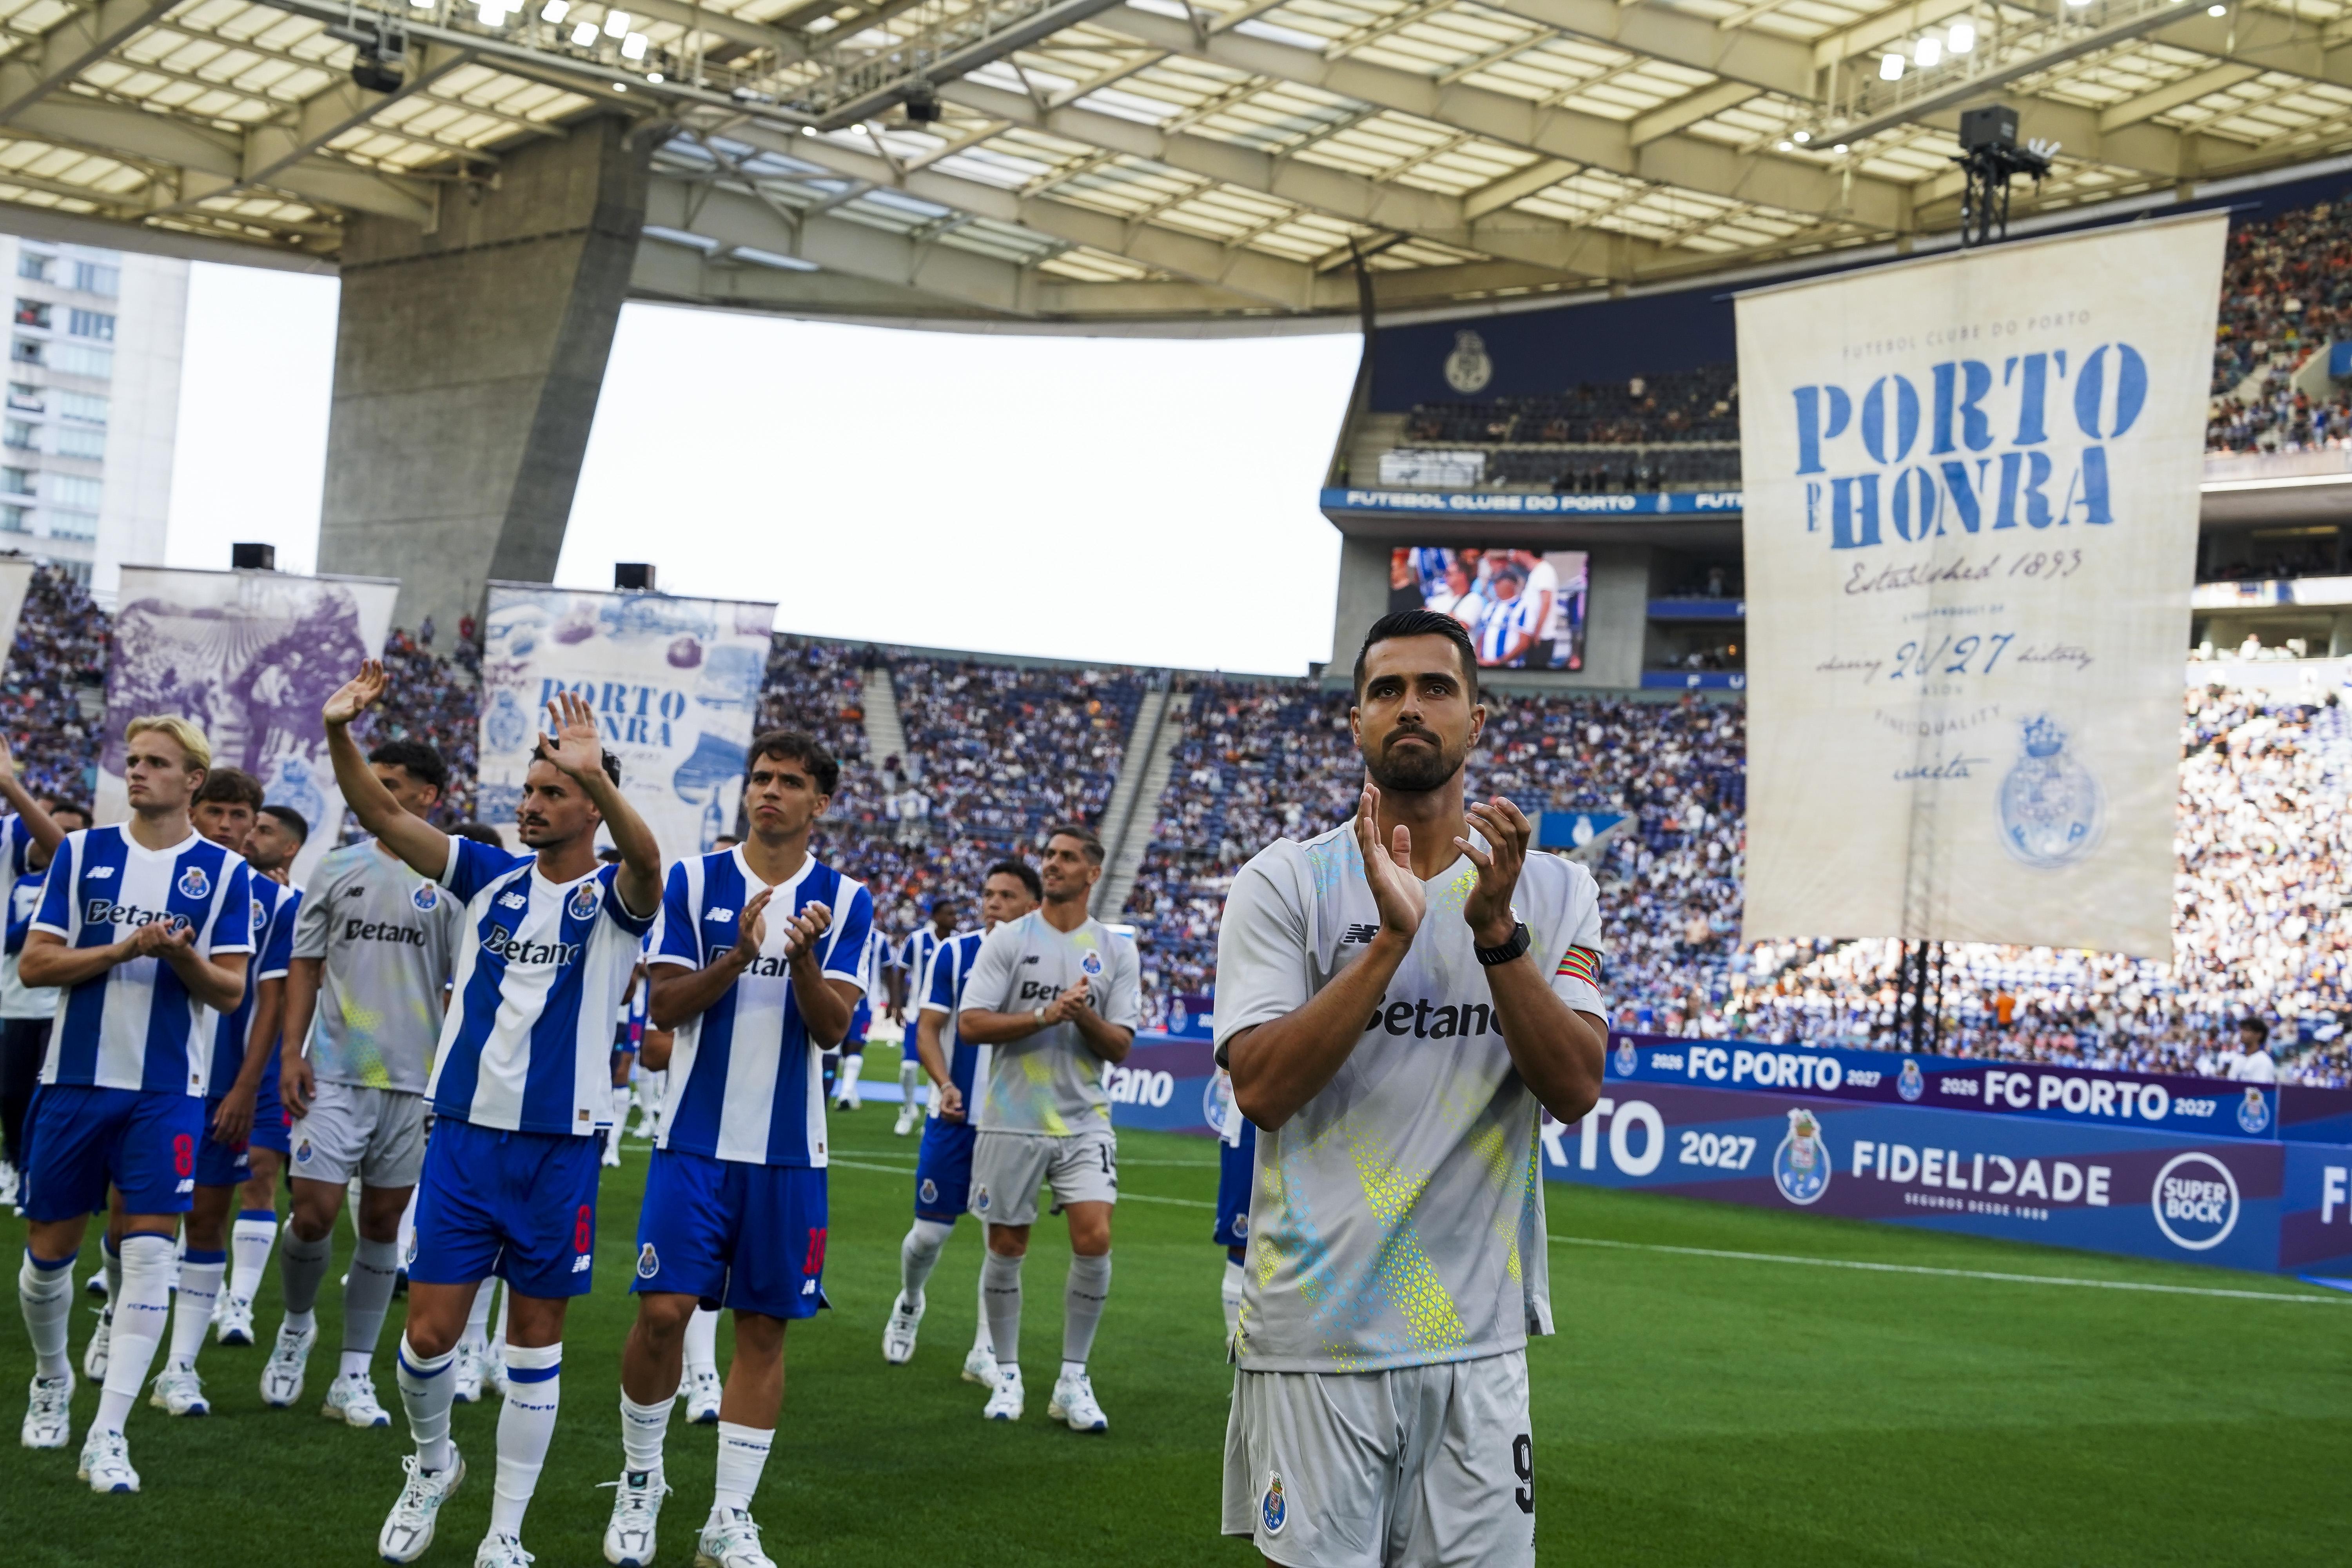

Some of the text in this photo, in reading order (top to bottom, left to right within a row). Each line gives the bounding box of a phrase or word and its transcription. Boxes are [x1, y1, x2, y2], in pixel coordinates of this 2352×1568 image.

[1843, 309, 2090, 359] FUTEBOL CLUBE DO PORTO
[1792, 343, 2149, 475] PORTO
[1347, 491, 1636, 512] FUTEBOL CLUBE DO PORTO
[1696, 492, 1744, 509] FUT
[1831, 445, 2114, 549] HONRA
[538, 677, 685, 720] PORTO
[1918, 703, 2000, 738] QUALITY
[344, 918, 426, 947] Betano
[1650, 1046, 1882, 1091] 2026 FC PORTO 2027
[1940, 1070, 2217, 1121] 2026 FC PORTO 2027
[173, 1134, 192, 1177] 8
[1678, 1130, 1757, 1171] 2027
[1852, 1139, 2112, 1207] FIDELIDADE
[2164, 1176, 2227, 1204] SUPER
[2165, 1198, 2223, 1224] BOCK
[2321, 1165, 2352, 1225] F
[574, 1205, 590, 1253] 6
[802, 1228, 827, 1275] 10
[1512, 1433, 1534, 1514] 9
